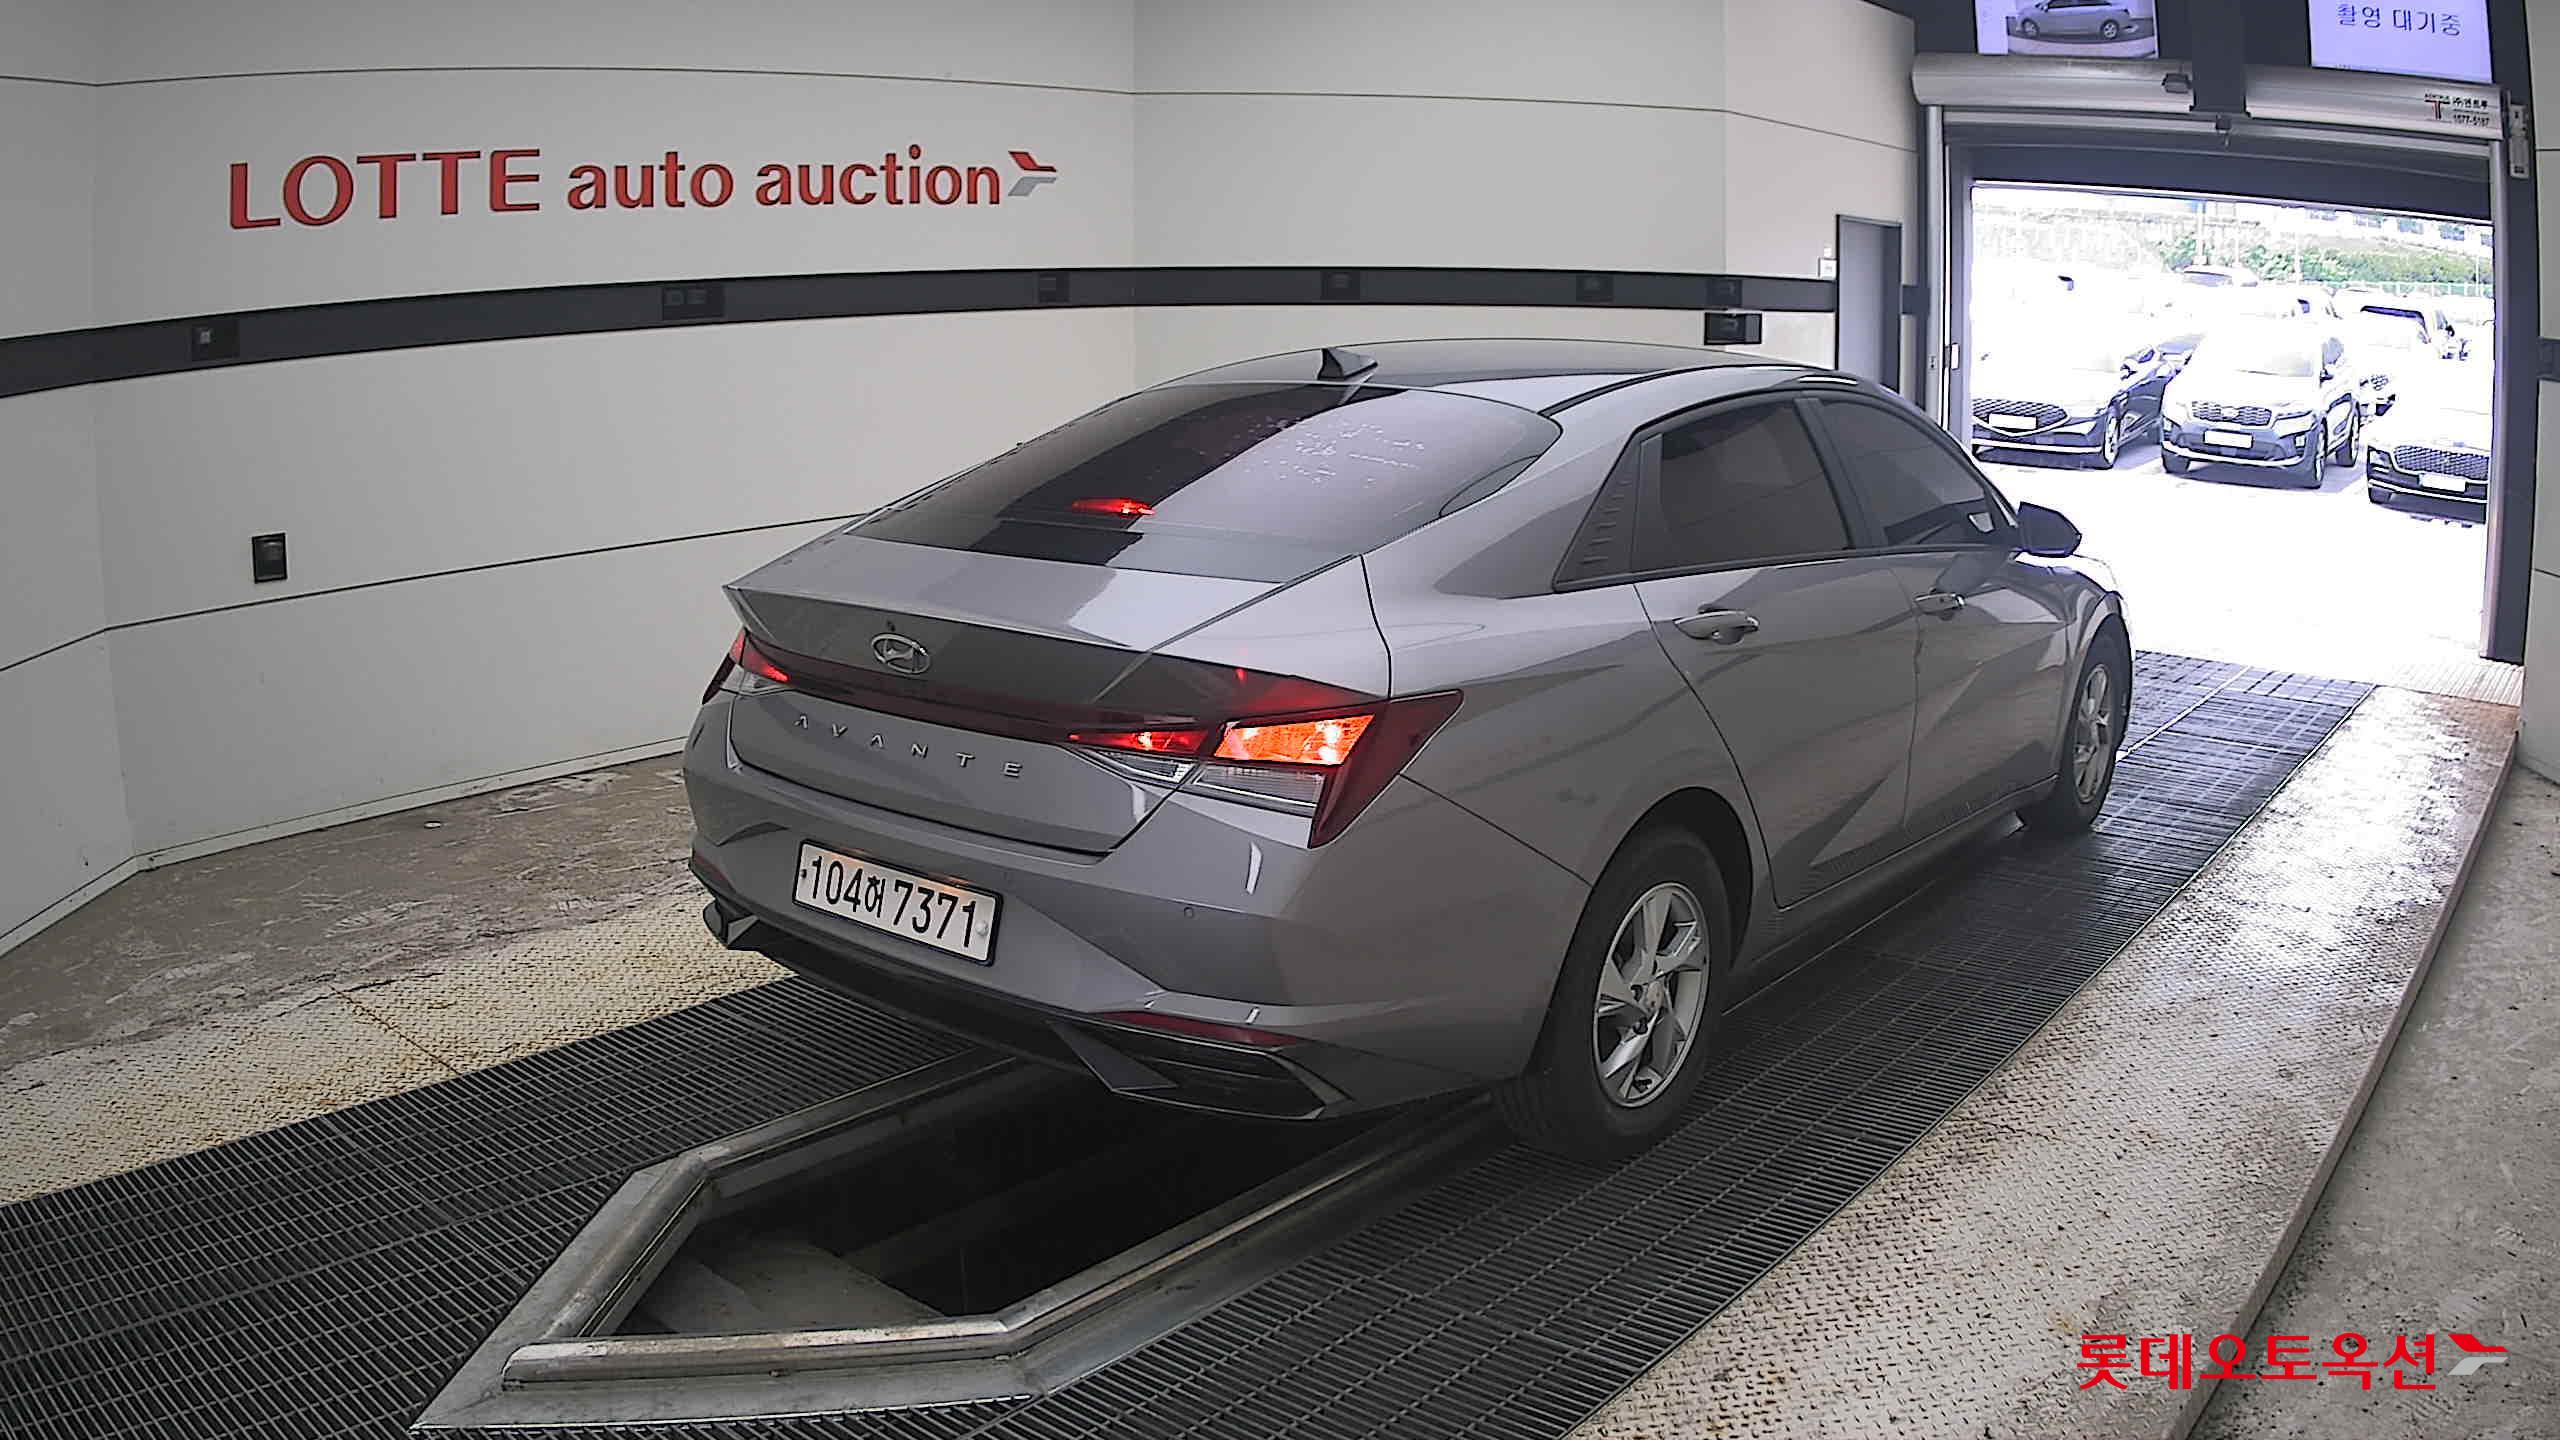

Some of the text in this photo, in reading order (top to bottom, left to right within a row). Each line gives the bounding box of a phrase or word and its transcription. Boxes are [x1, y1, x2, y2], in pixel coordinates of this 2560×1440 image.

[2337, 3, 2461, 37] 촬영 대기중
[229, 146, 1002, 230] LOTTE auto auction
[793, 713, 1023, 778] AVANTE
[811, 855, 977, 948] 104허 7371
